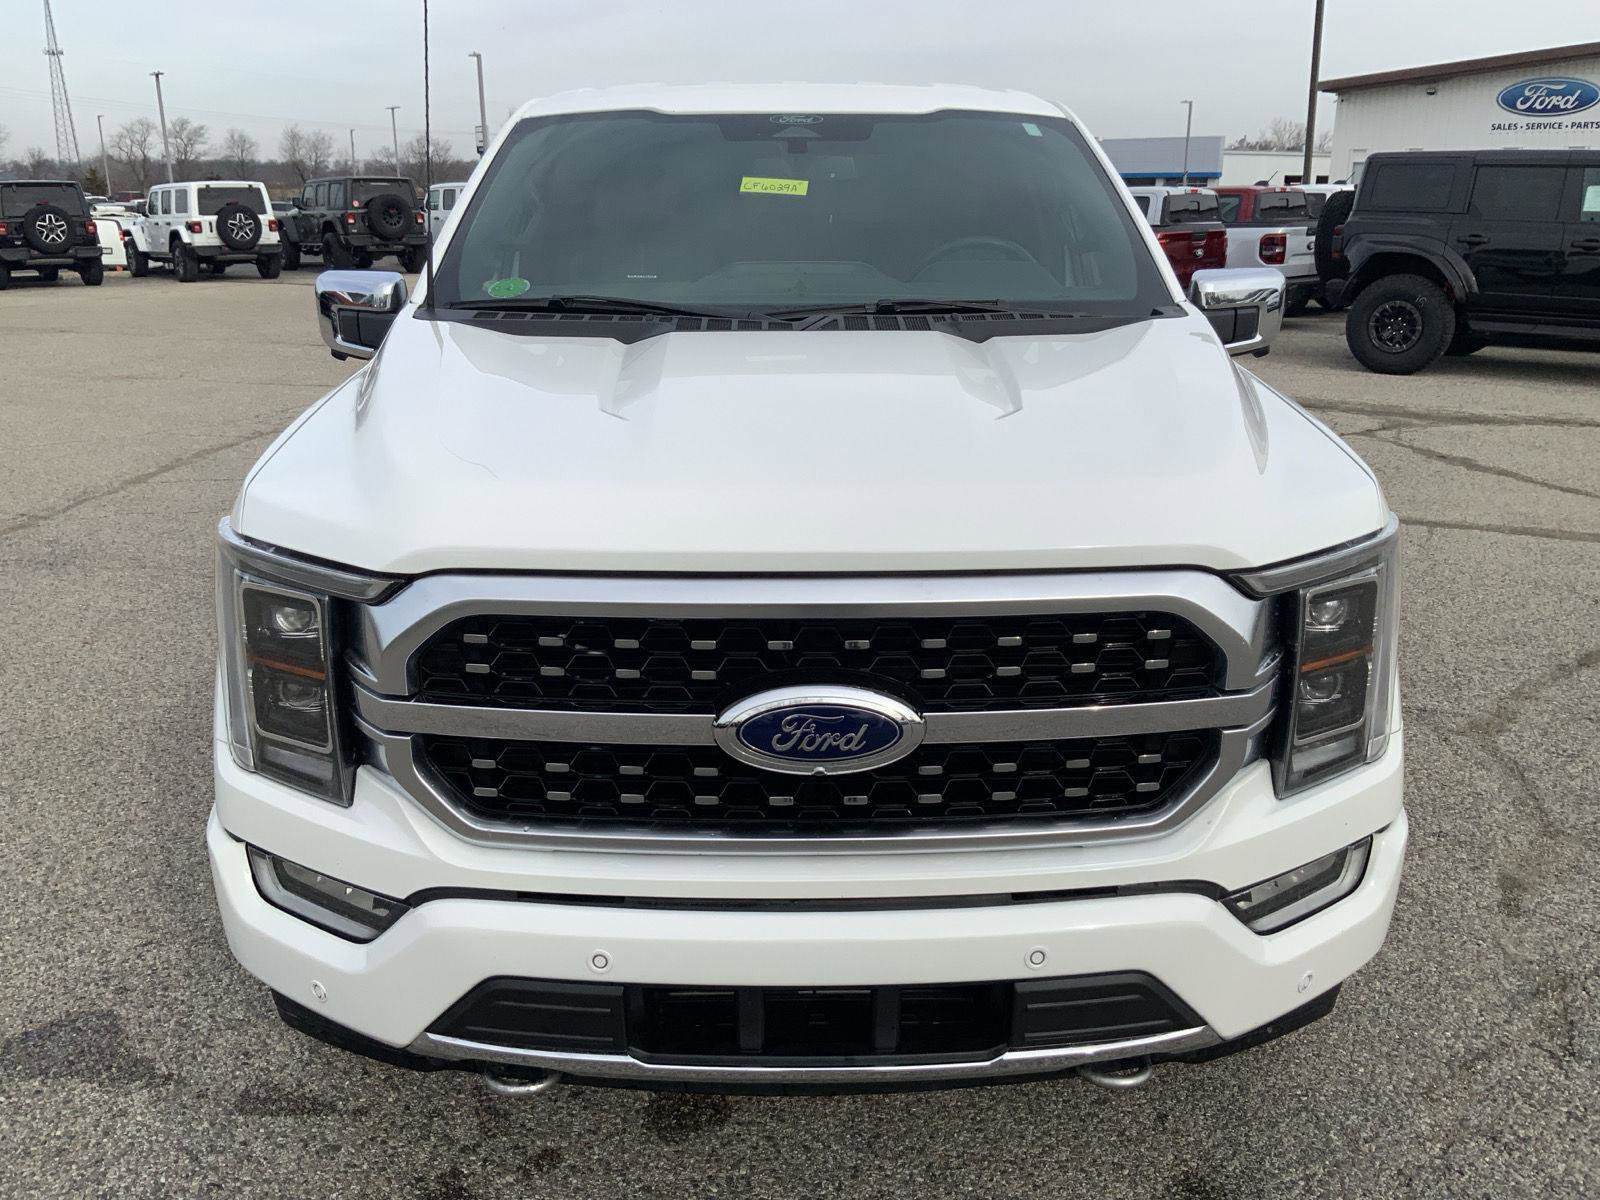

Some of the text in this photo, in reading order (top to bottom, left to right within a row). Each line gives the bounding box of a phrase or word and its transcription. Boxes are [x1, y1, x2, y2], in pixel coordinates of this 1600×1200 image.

[1516, 83, 1582, 110] Ford
[1491, 121, 1600, 131] SALES SERVICE PARTS
[771, 713, 868, 752] Ford
